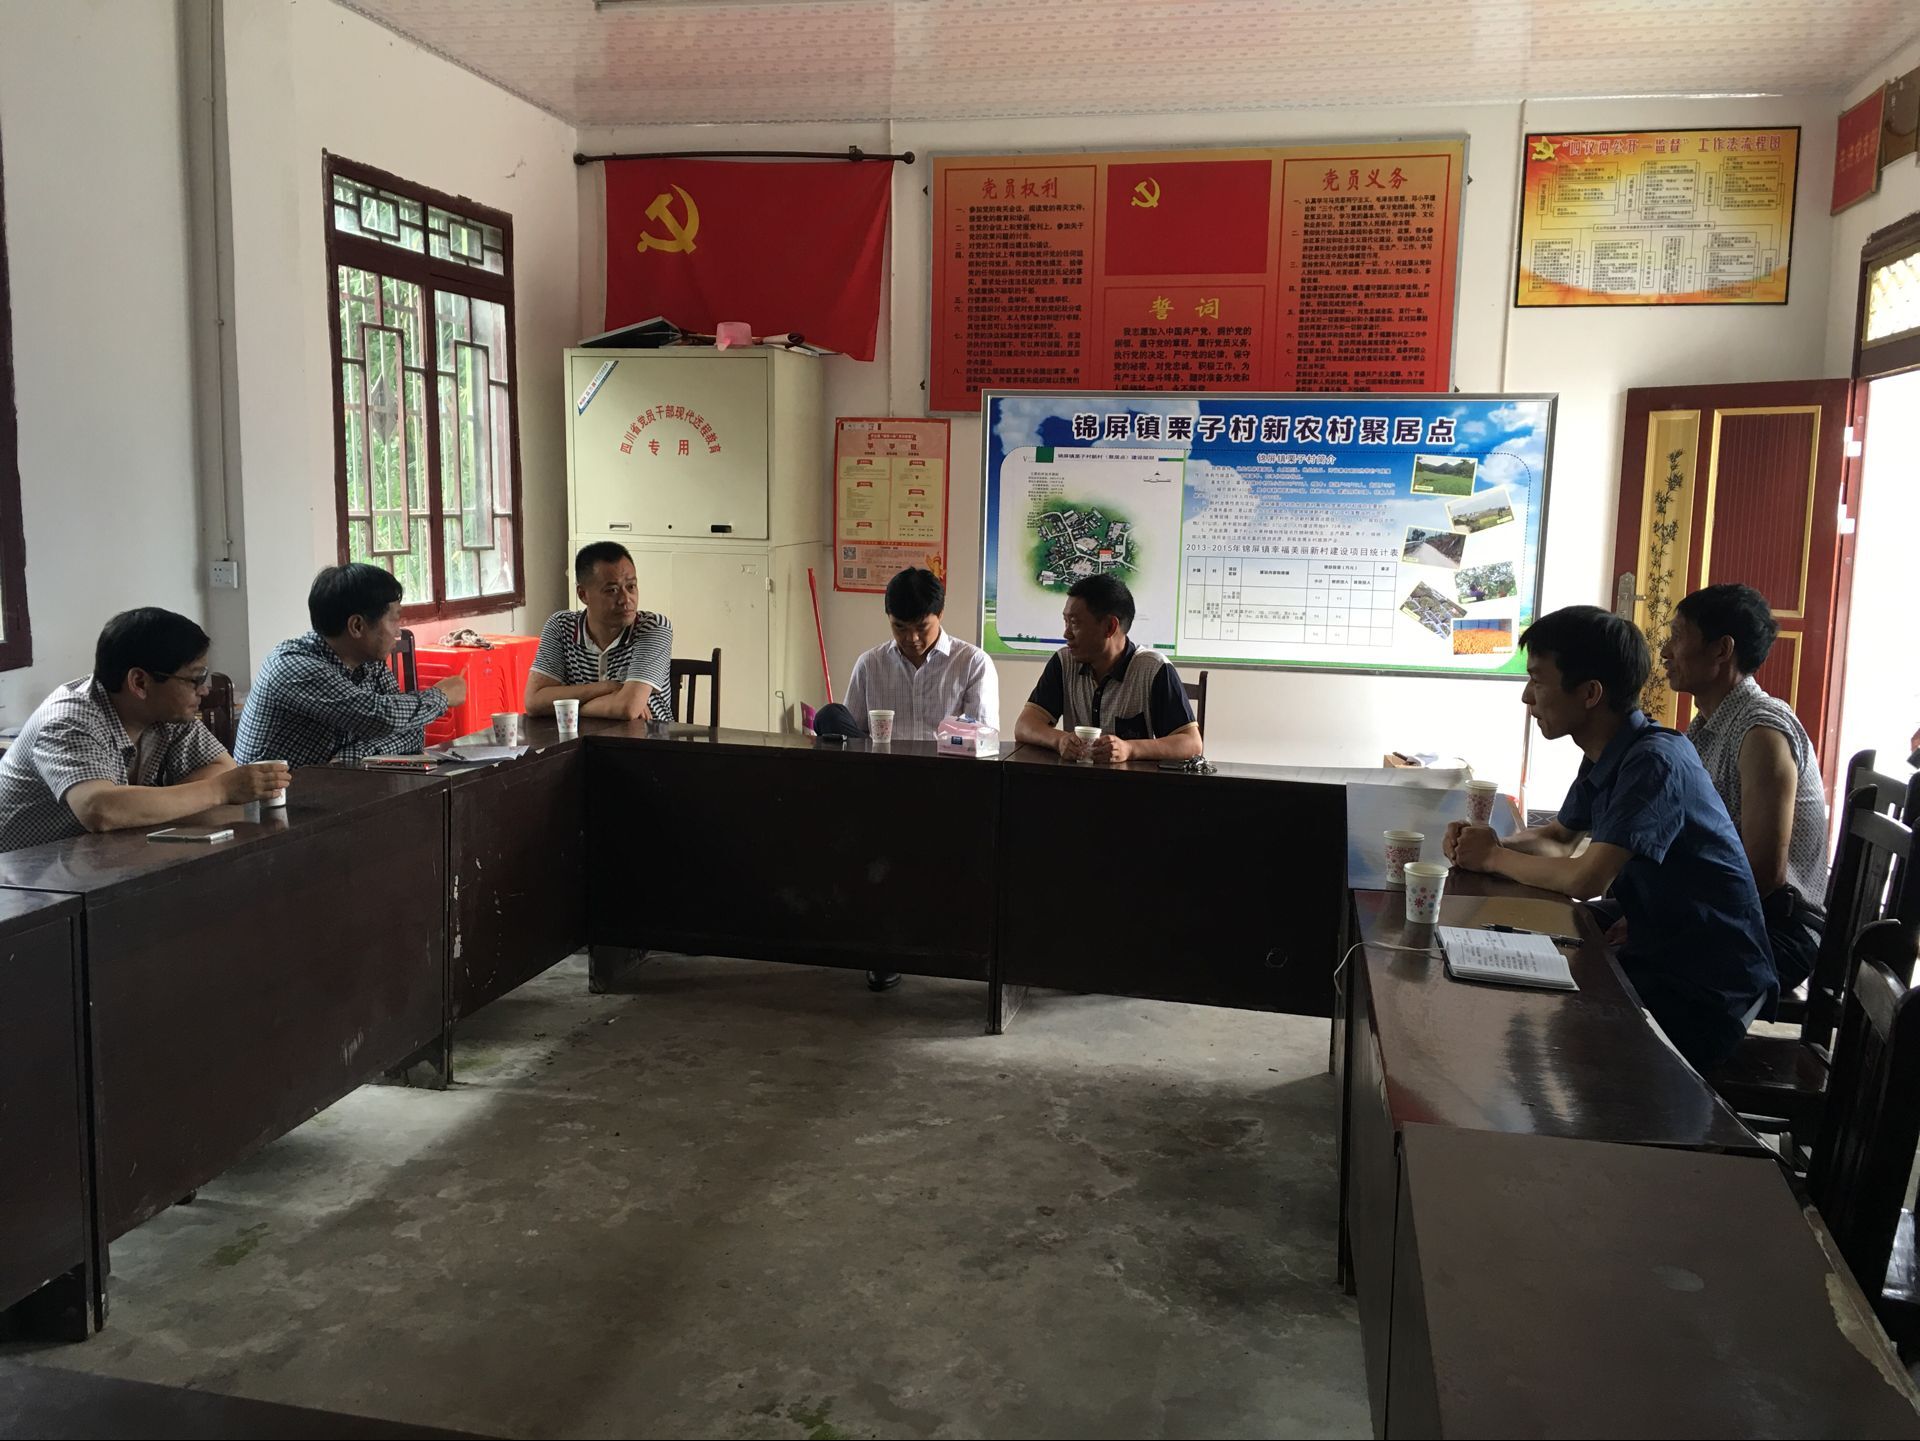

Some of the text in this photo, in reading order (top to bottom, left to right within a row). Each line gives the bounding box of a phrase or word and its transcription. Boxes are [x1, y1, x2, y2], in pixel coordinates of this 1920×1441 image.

[982, 177, 1058, 199] 党员权利
[1323, 167, 1408, 191] 党员义务
[620, 404, 722, 455] 四川省党员干部现代远程教育
[1072, 413, 1457, 445] 锦屏镇栗子村新农村聚居点
[648, 439, 690, 456] 专用
[1257, 454, 1336, 465] 锦屏镇栗子村简介
[1186, 543, 1399, 557] 2013-2015年锦屏镇幸福美丽新村建设项目统计表
